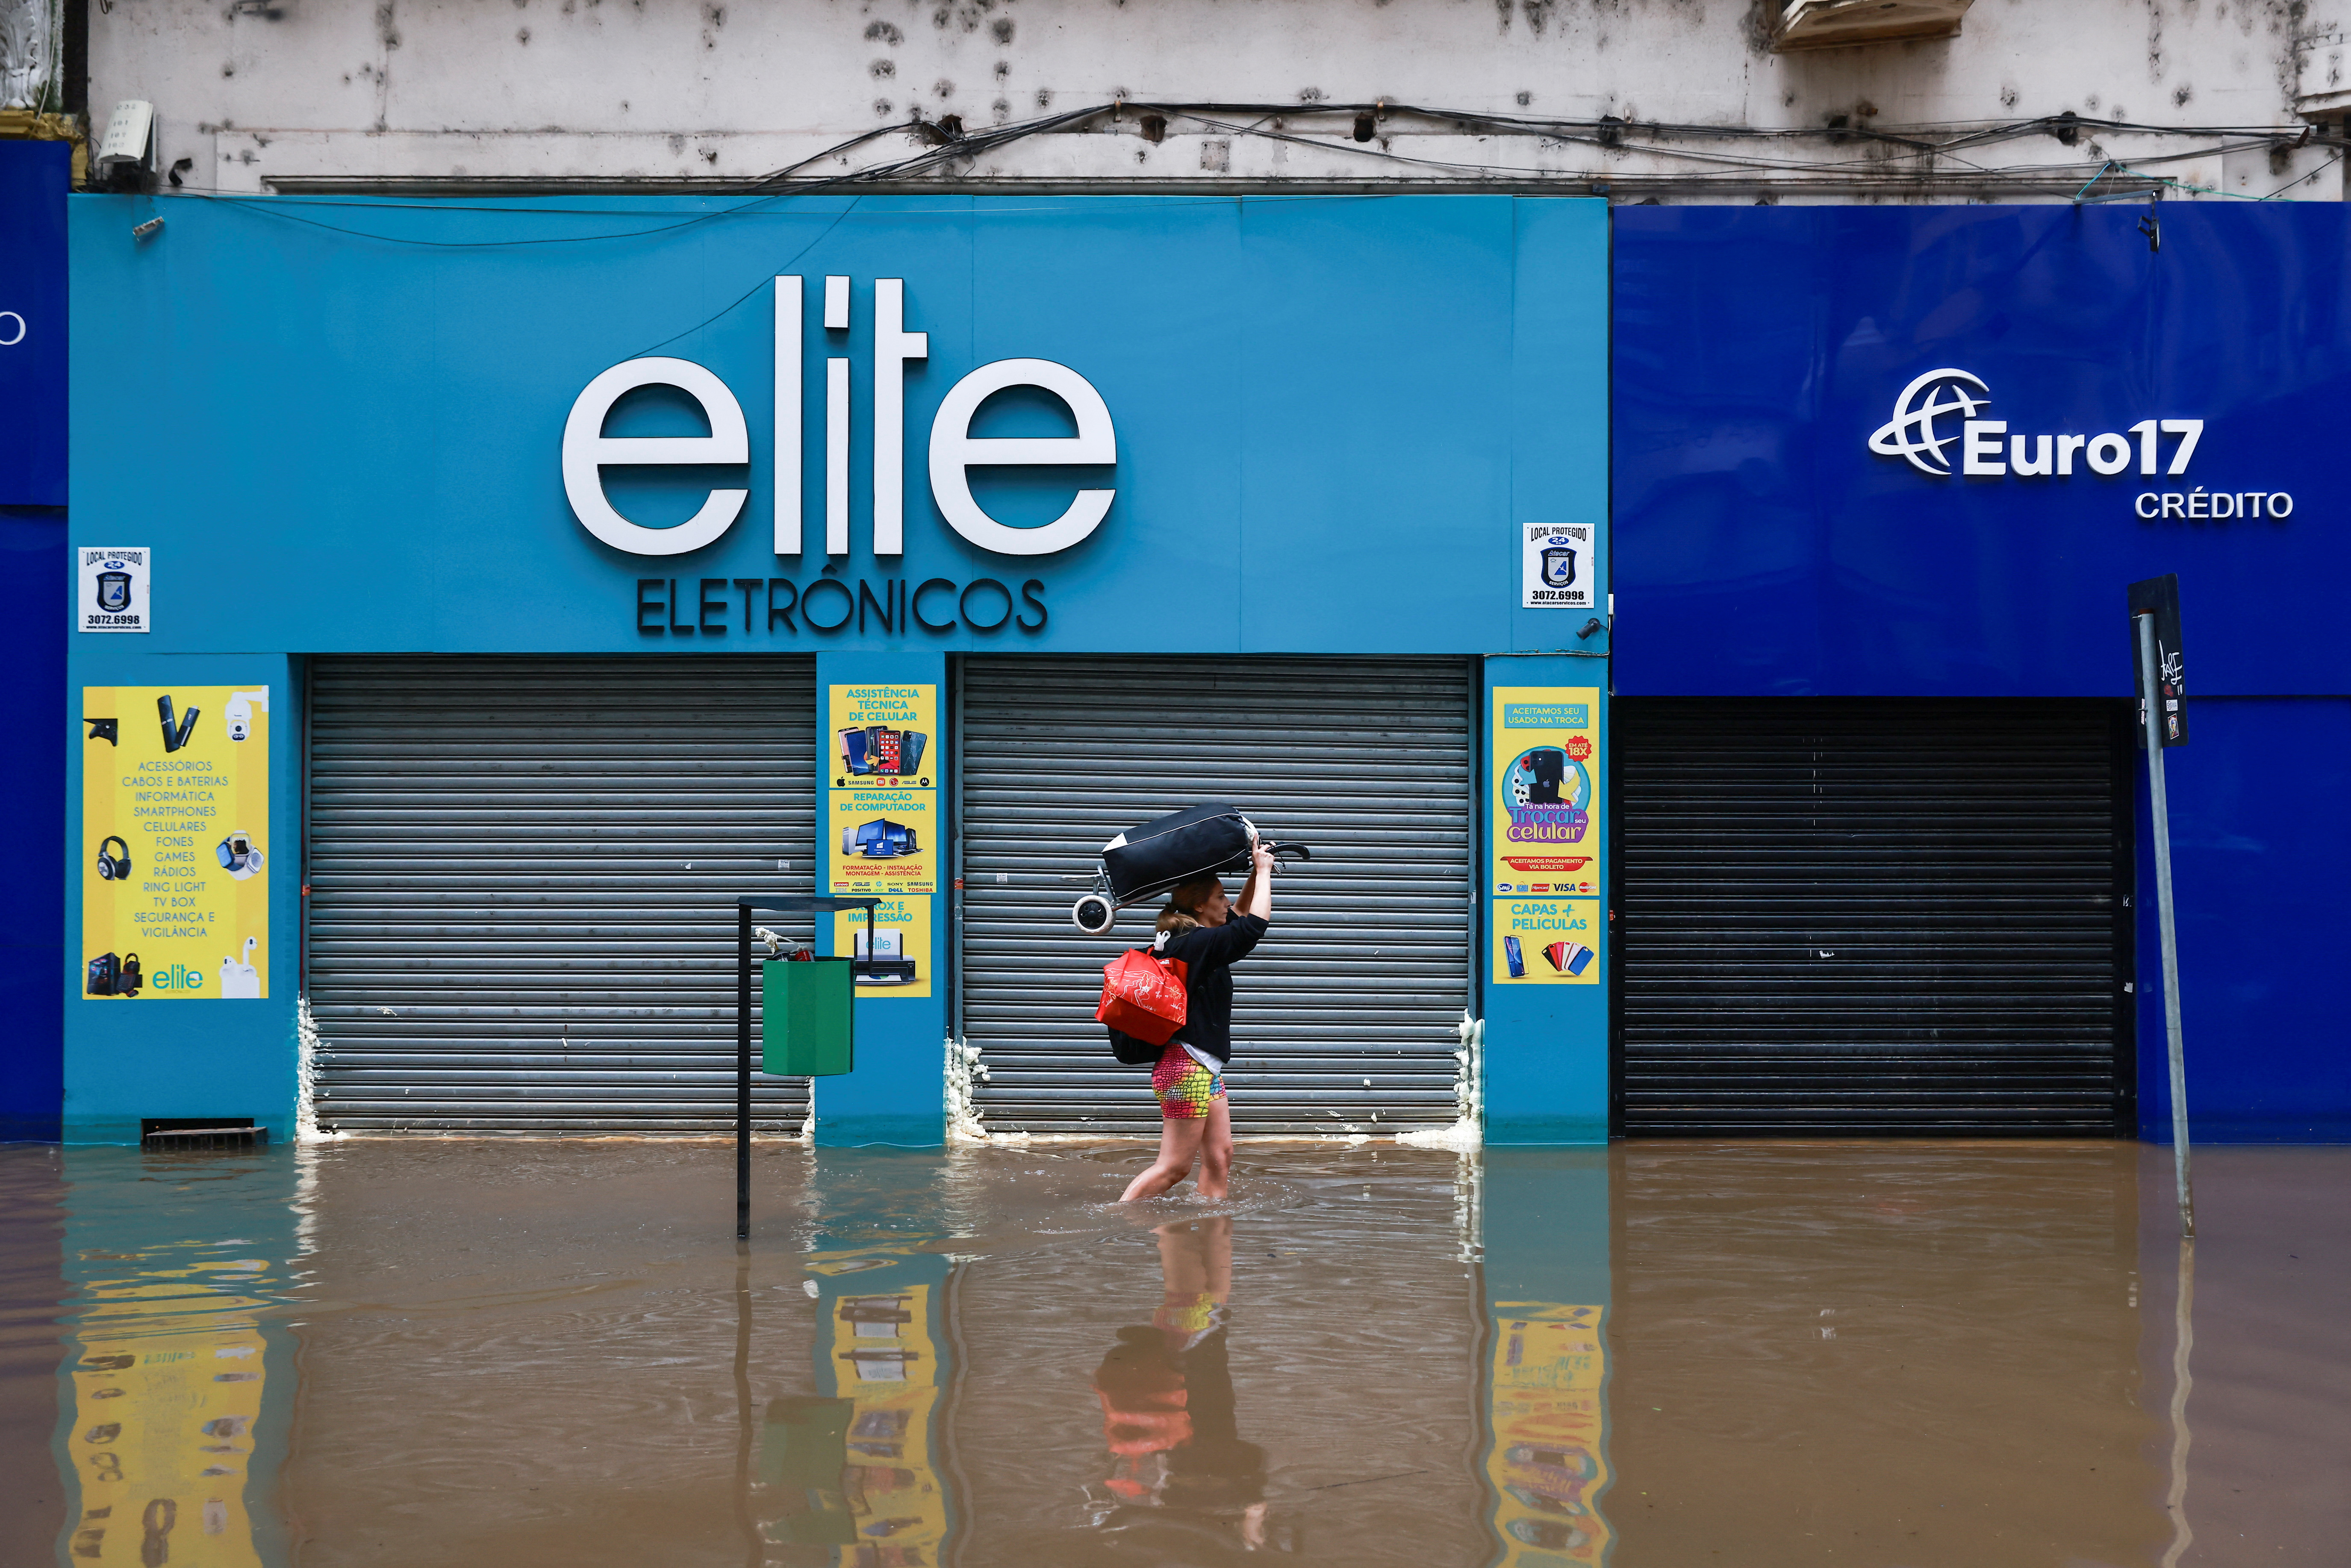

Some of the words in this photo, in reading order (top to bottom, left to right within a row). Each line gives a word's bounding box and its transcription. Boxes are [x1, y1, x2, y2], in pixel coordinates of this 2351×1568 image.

[562, 275, 1117, 556] elite
[1963, 419, 2204, 475] Euro17
[2136, 486, 2293, 518] CRÉDITO
[1531, 527, 1550, 542] LOCAL
[1552, 527, 1586, 542] PROTEGIDO
[87, 552, 106, 566] LOCAL
[107, 552, 142, 566] PROTEGIDO
[637, 564, 1047, 632] ELETRÔNICOS
[1533, 591, 1584, 600] 3072.6998
[88, 615, 139, 624] 3072.6998
[846, 687, 919, 698] ASSISTÊNCIA
[857, 698, 908, 709] TÉCNICA
[849, 712, 864, 721] DE
[867, 712, 917, 721] CELULAR
[1569, 747, 1588, 756] 18X
[138, 760, 212, 771] ACESSÓRIOS
[122, 777, 162, 787] CABOS
[167, 777, 173, 786] E
[177, 776, 228, 786] BATERIAS
[136, 790, 214, 801] INFORMÁTICA
[854, 791, 912, 802] REPARAÇÃO
[134, 807, 216, 816] SMARTPHONES
[1509, 808, 1581, 823] Trocar
[144, 822, 206, 831] CELULARES
[1508, 822, 1582, 840] celular
[156, 837, 194, 846] FONES
[155, 852, 195, 861] GAMES
[154, 866, 196, 876] RÁDIOS
[143, 882, 170, 892] RING
[175, 882, 206, 892] LIGHT
[1552, 884, 1576, 892] VISA
[153, 897, 167, 907] TV
[171, 897, 195, 907] BOX
[898, 902, 904, 910] E
[1511, 904, 1557, 915] CAPAS
[134, 912, 204, 923] SEGURANÇA
[209, 912, 214, 922] E
[848, 911, 912, 922] IMPRESSÃO
[1512, 914, 1587, 930] PELÍCULAS
[142, 925, 207, 937] VIGILÂNCIA
[153, 964, 203, 989] elite
